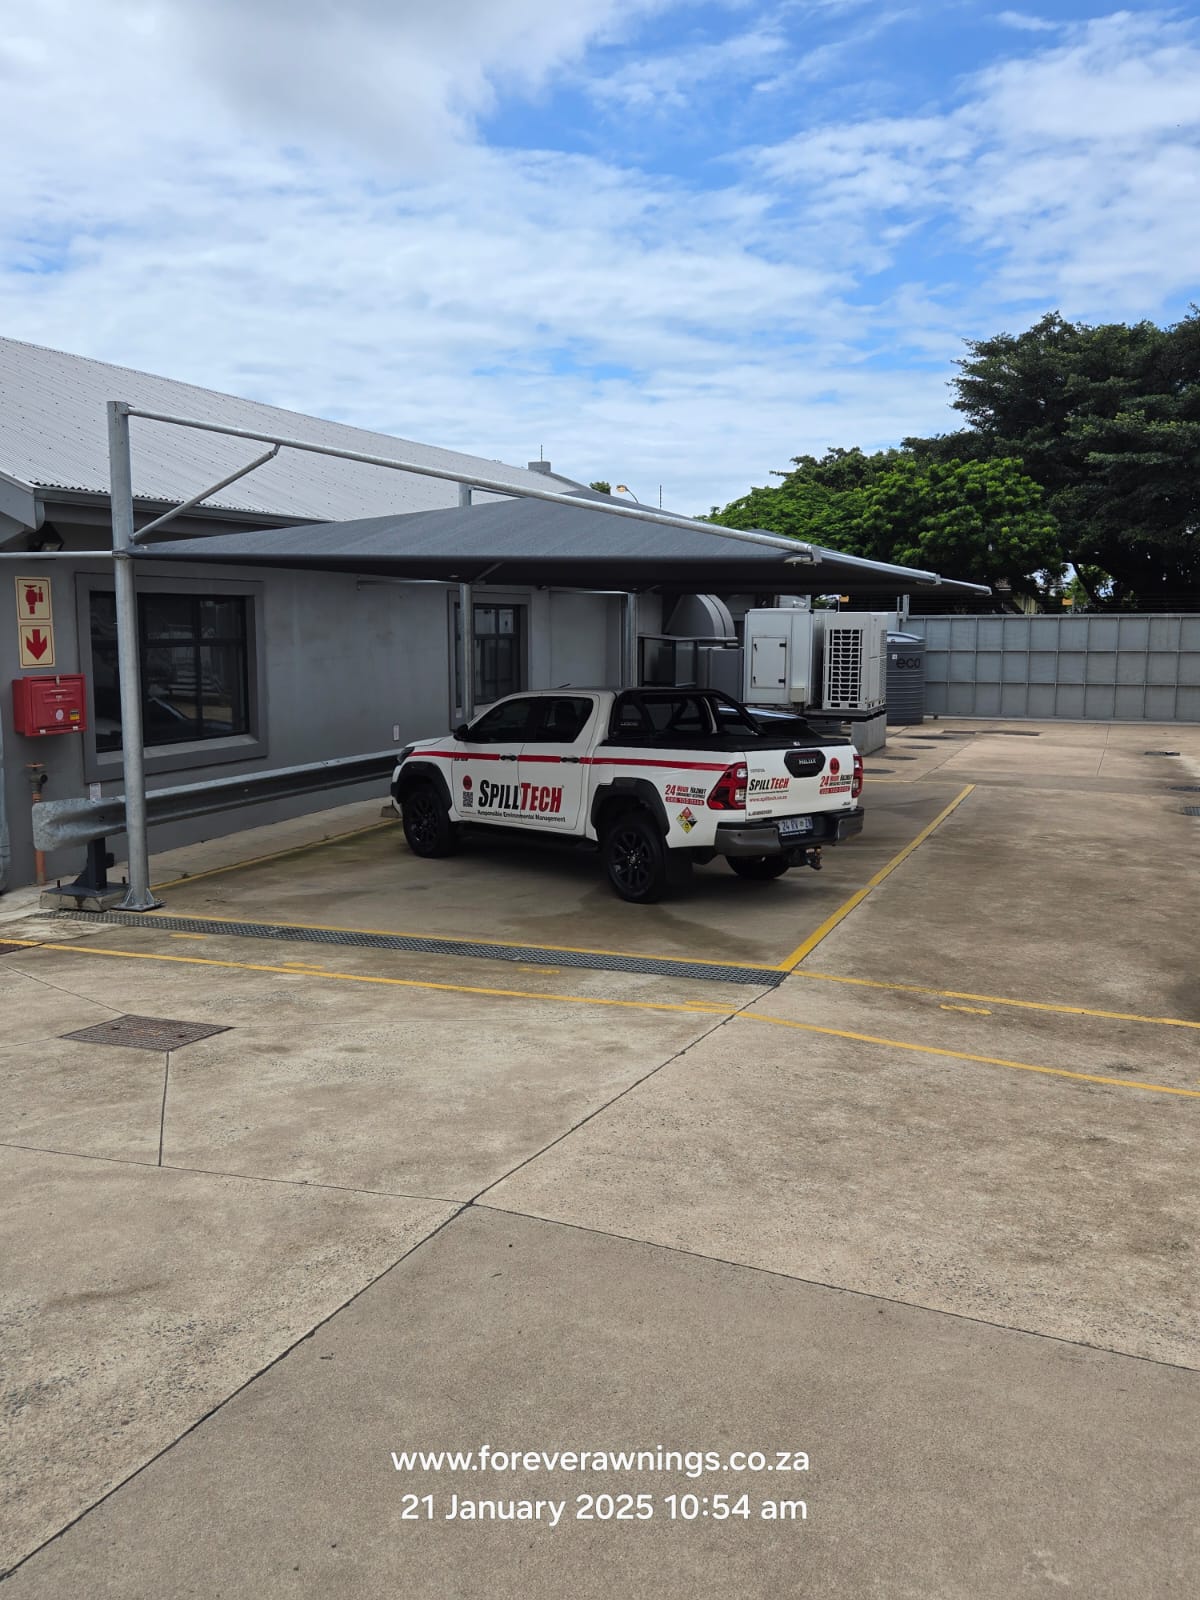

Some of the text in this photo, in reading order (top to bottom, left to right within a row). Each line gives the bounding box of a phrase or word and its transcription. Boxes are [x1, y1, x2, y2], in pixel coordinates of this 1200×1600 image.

[896, 657, 921, 669] eco
[819, 775, 830, 787] 24
[665, 784, 676, 796] 24
[535, 814, 566, 823] Management
